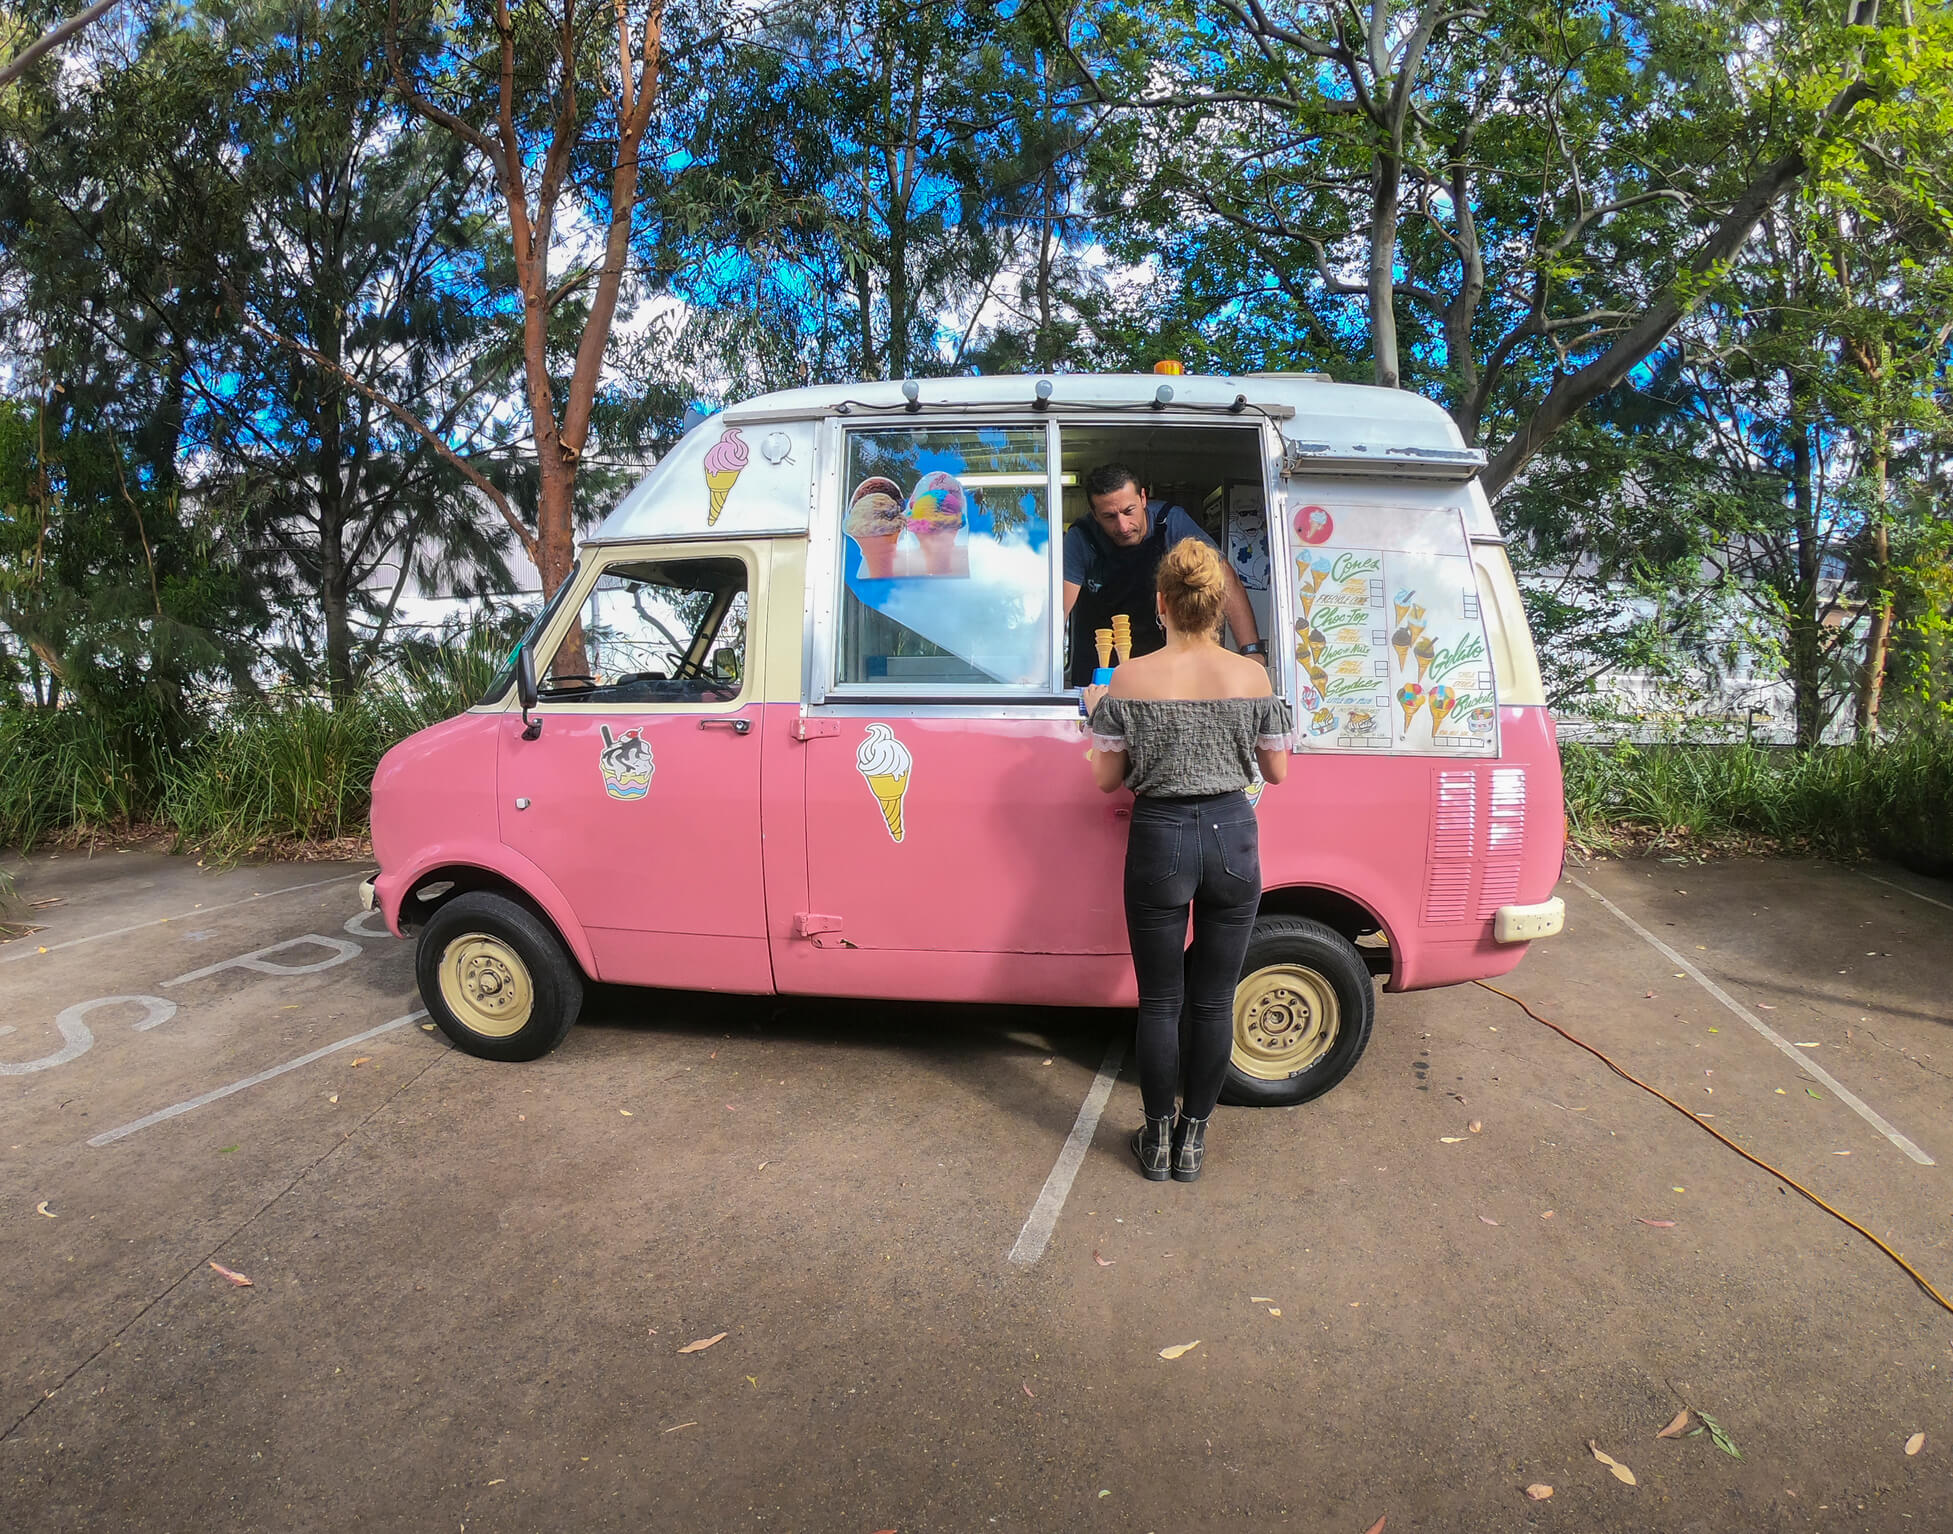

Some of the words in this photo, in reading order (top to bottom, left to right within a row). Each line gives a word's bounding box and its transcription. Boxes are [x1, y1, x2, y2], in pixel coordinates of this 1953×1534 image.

[1331, 552, 1381, 582] Cones
[1311, 607, 1369, 629] Choc-Top
[1429, 632, 1484, 680] Gelato
[1451, 690, 1495, 719] Buckets
